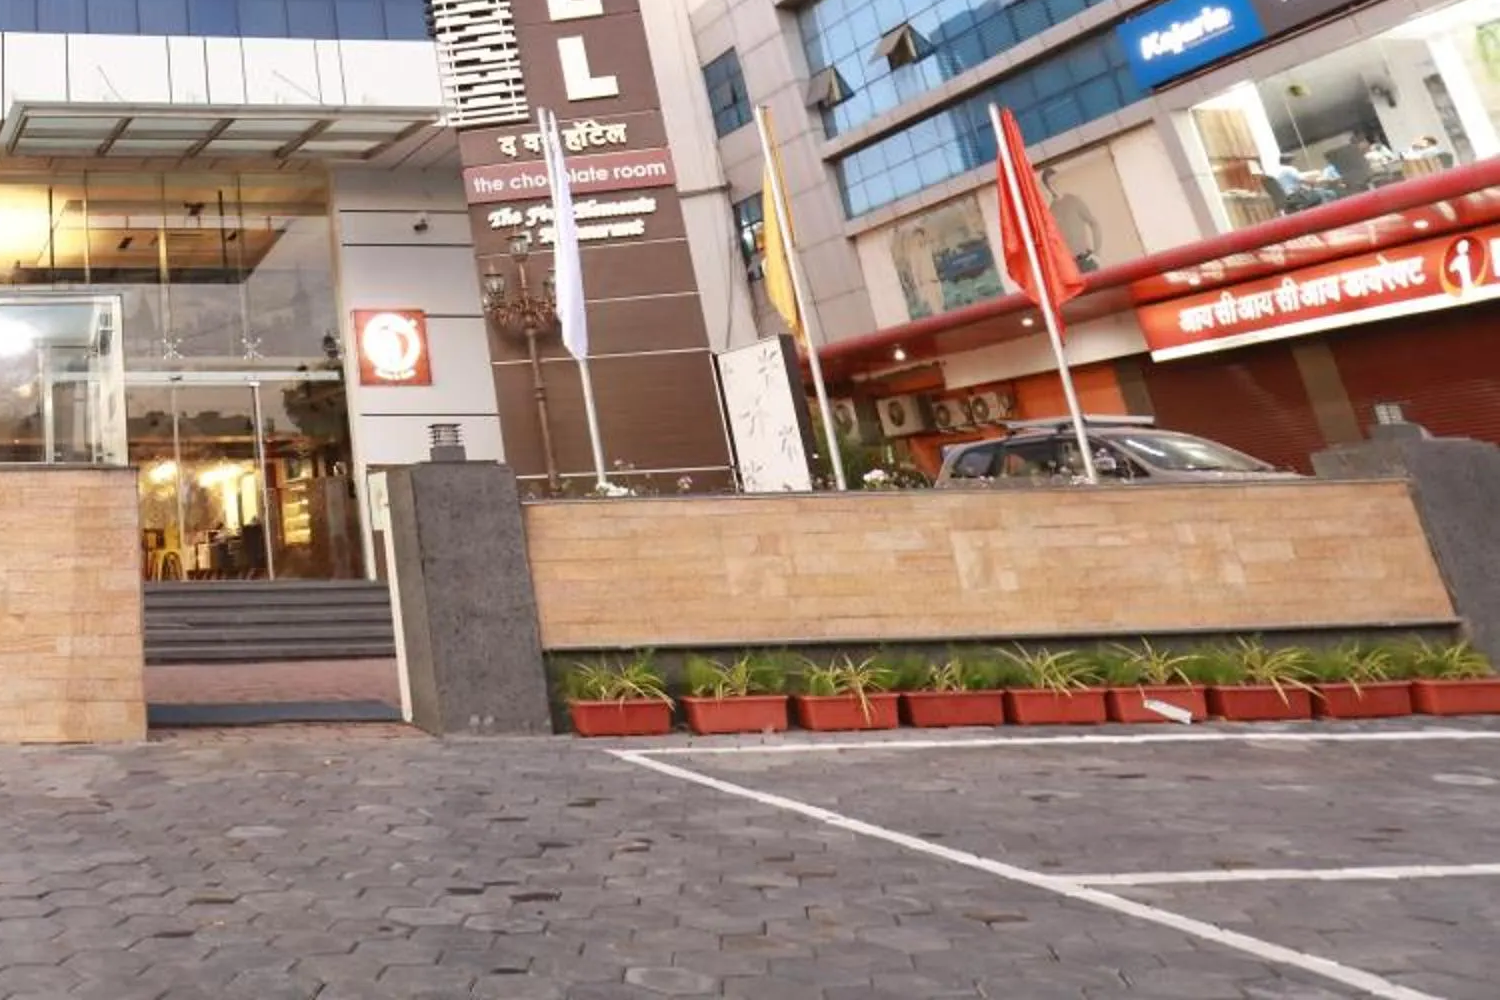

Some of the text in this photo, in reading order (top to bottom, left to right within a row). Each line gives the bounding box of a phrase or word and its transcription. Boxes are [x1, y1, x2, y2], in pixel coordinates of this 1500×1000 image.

[473, 162, 666, 194] the cholate room
